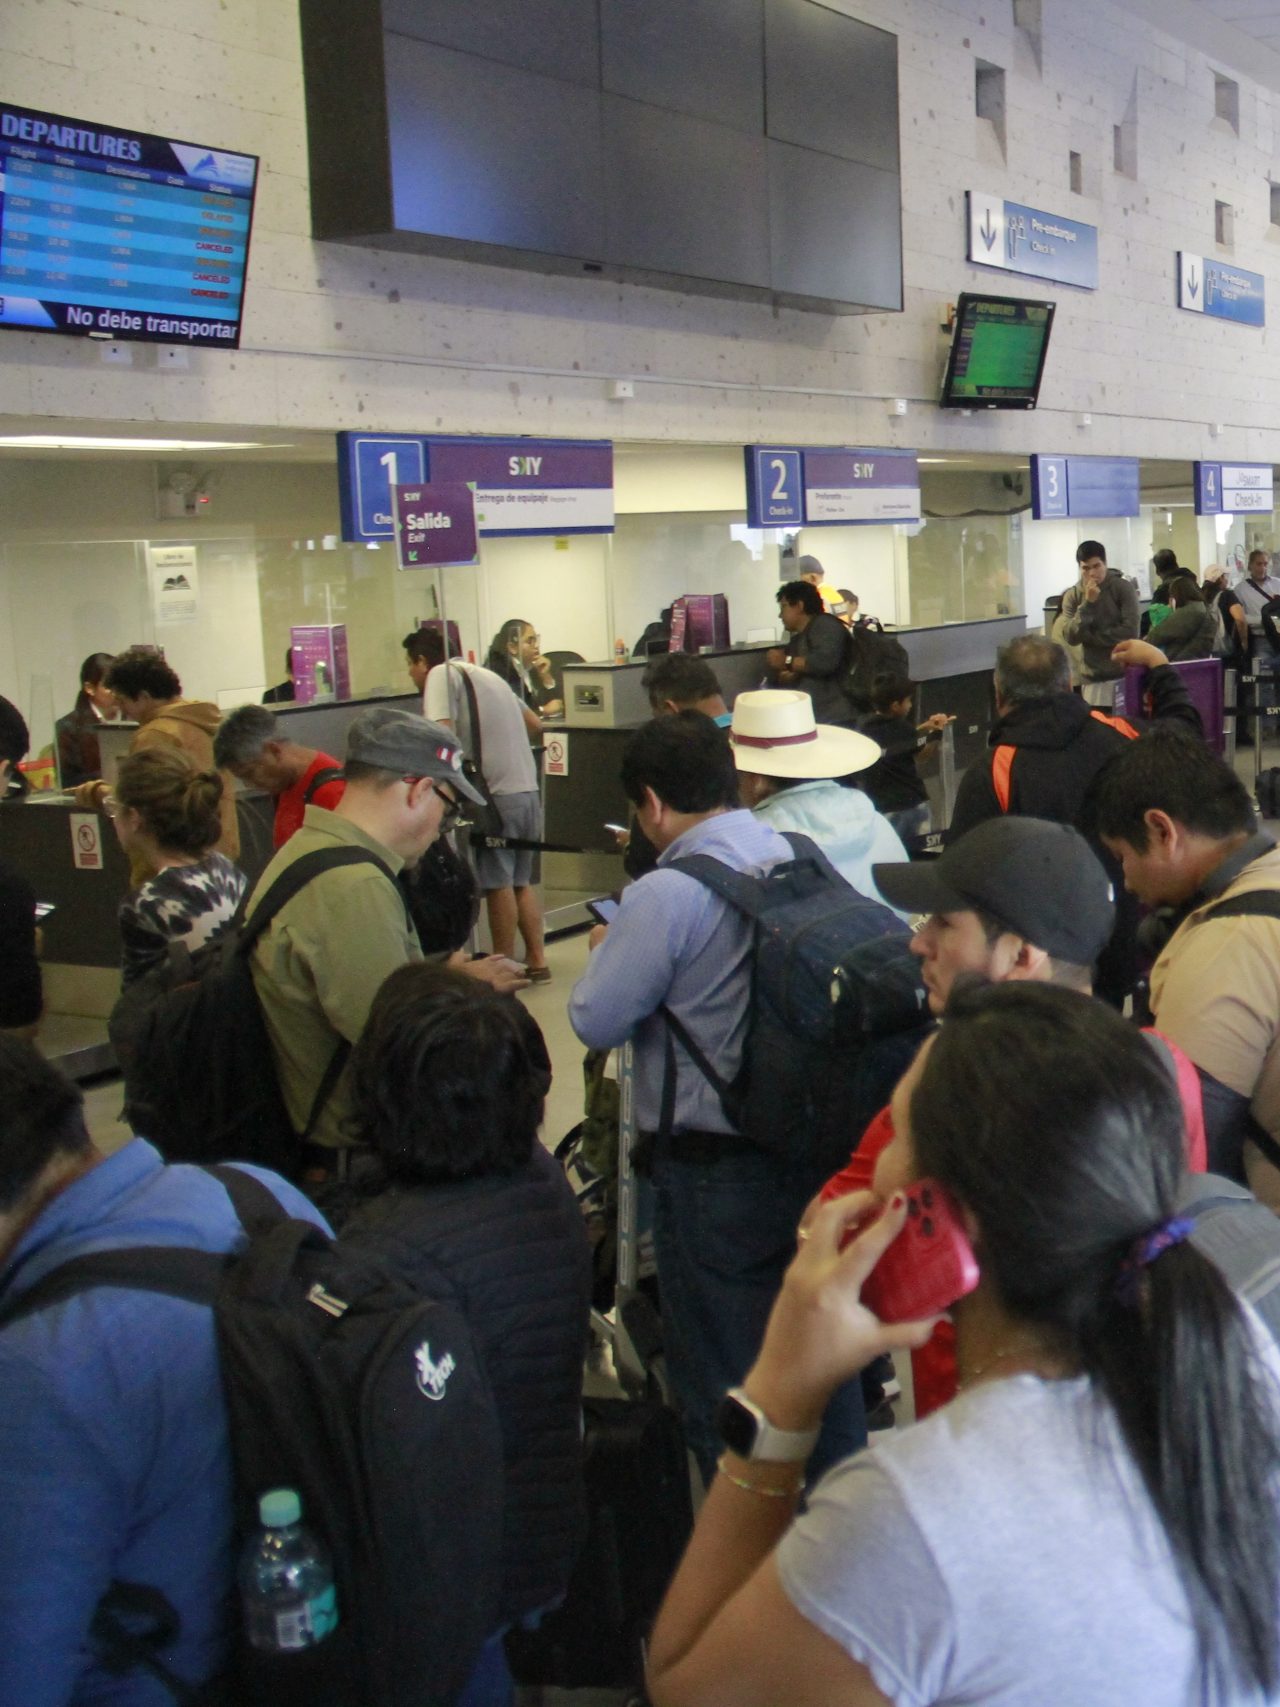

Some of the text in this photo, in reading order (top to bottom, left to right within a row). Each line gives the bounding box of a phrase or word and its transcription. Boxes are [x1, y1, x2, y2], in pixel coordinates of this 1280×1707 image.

[1, 114, 142, 162] DEPARTURES
[195, 241, 234, 254] CANCELED
[192, 272, 231, 285] CANCELED
[67, 306, 93, 326] No
[98, 310, 142, 330] debe
[380, 451, 398, 485] 1
[509, 456, 542, 476] SKY
[771, 459, 788, 500] 2
[1048, 465, 1058, 497] 3
[1206, 470, 1215, 498] 4
[506, 492, 515, 503] de
[517, 492, 548, 504] equipaje
[406, 512, 451, 530] Salida
[408, 532, 425, 543] Exit
